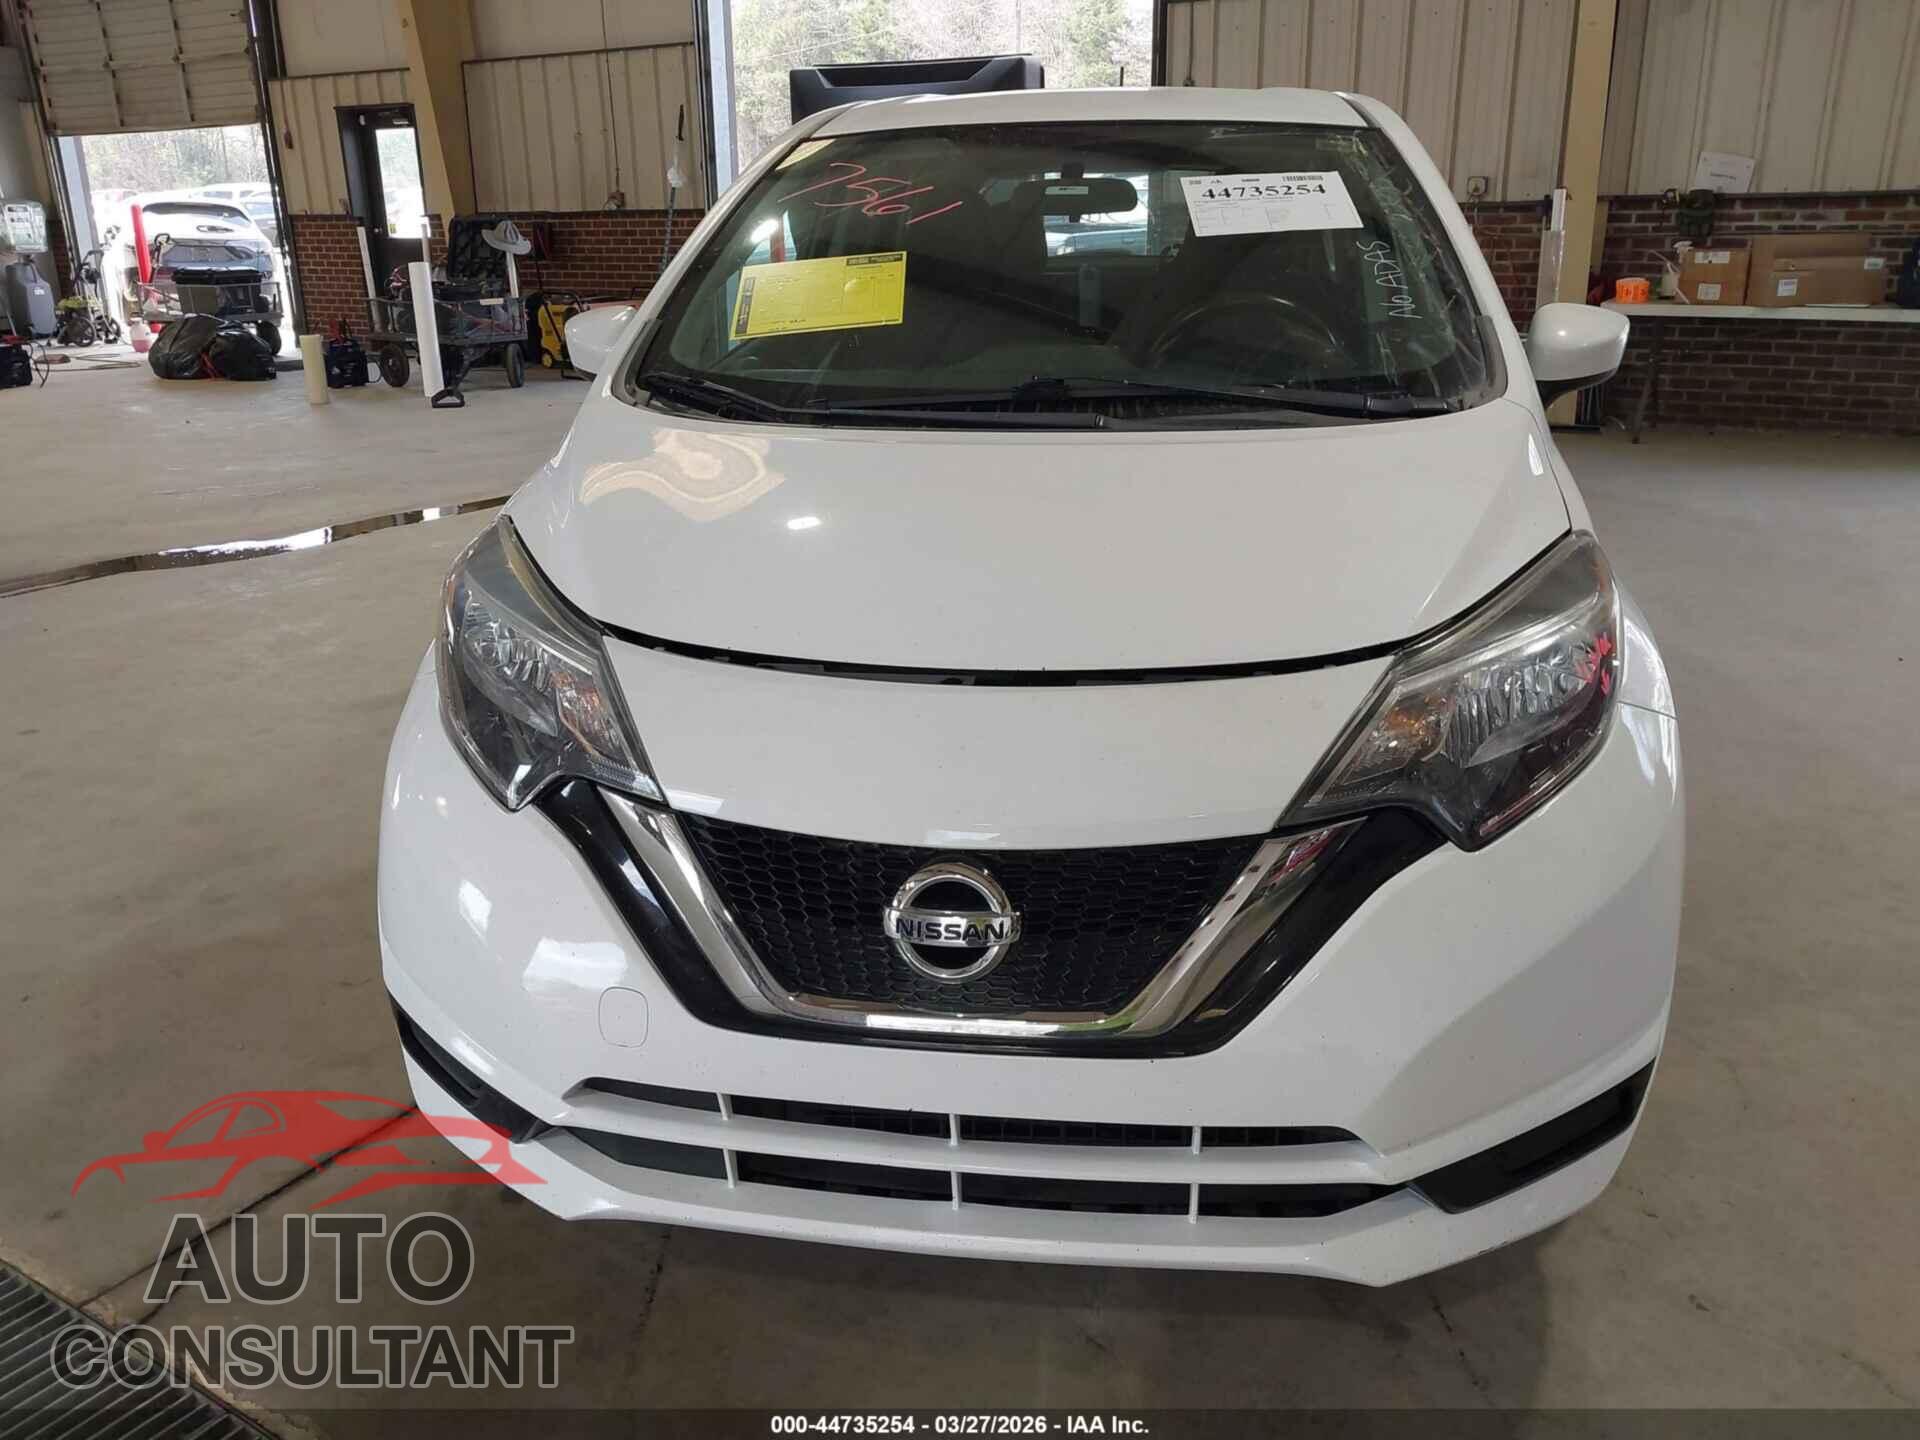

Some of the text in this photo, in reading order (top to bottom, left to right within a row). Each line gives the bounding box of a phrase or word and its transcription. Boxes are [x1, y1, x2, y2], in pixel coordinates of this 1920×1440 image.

[777, 162, 964, 226] 7561
[1201, 183, 1328, 200] 44735254
[1355, 240, 1409, 290] ADAS
[895, 917, 1005, 942] NISSAN
